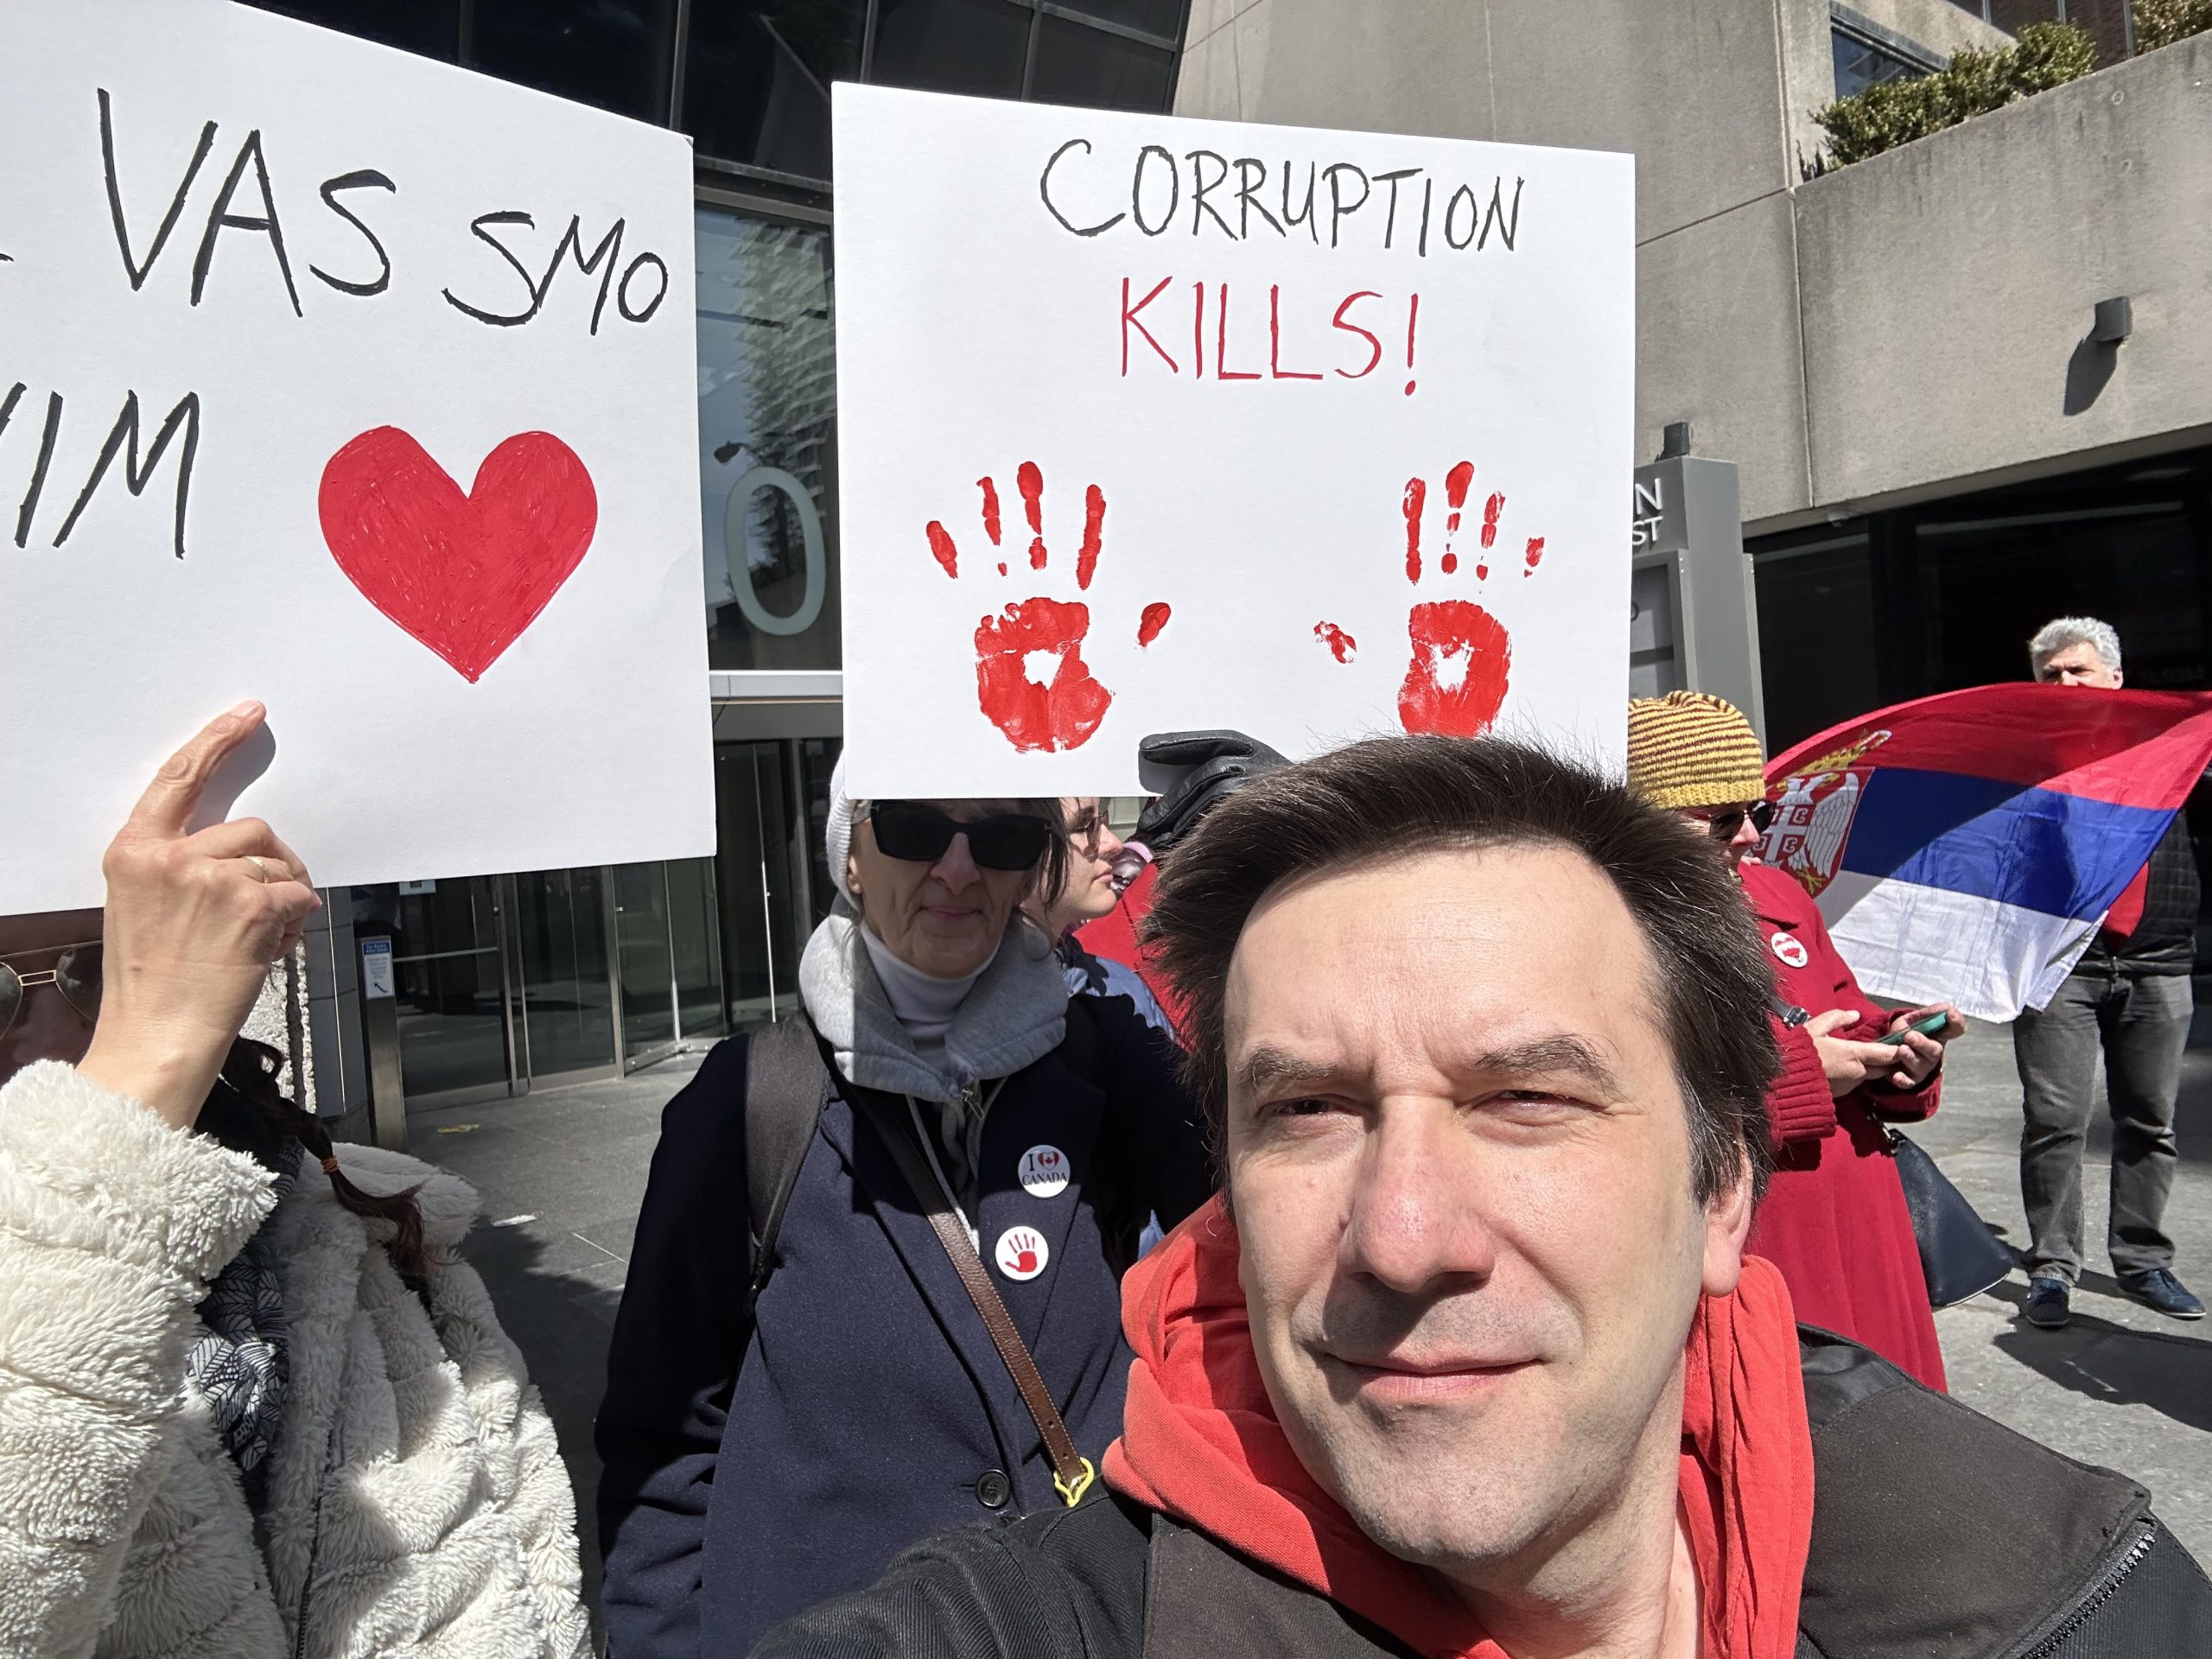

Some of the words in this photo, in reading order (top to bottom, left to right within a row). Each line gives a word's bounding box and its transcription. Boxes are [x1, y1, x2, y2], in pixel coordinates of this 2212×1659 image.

[97, 87, 396, 317] VAS
[442, 211, 668, 336] SMO
[1040, 139, 1524, 256] CORRUPTION
[1122, 276, 1420, 397] KILLS!
[1021, 1172, 1068, 1186] CANADA
[1027, 1154, 1035, 1172] I
